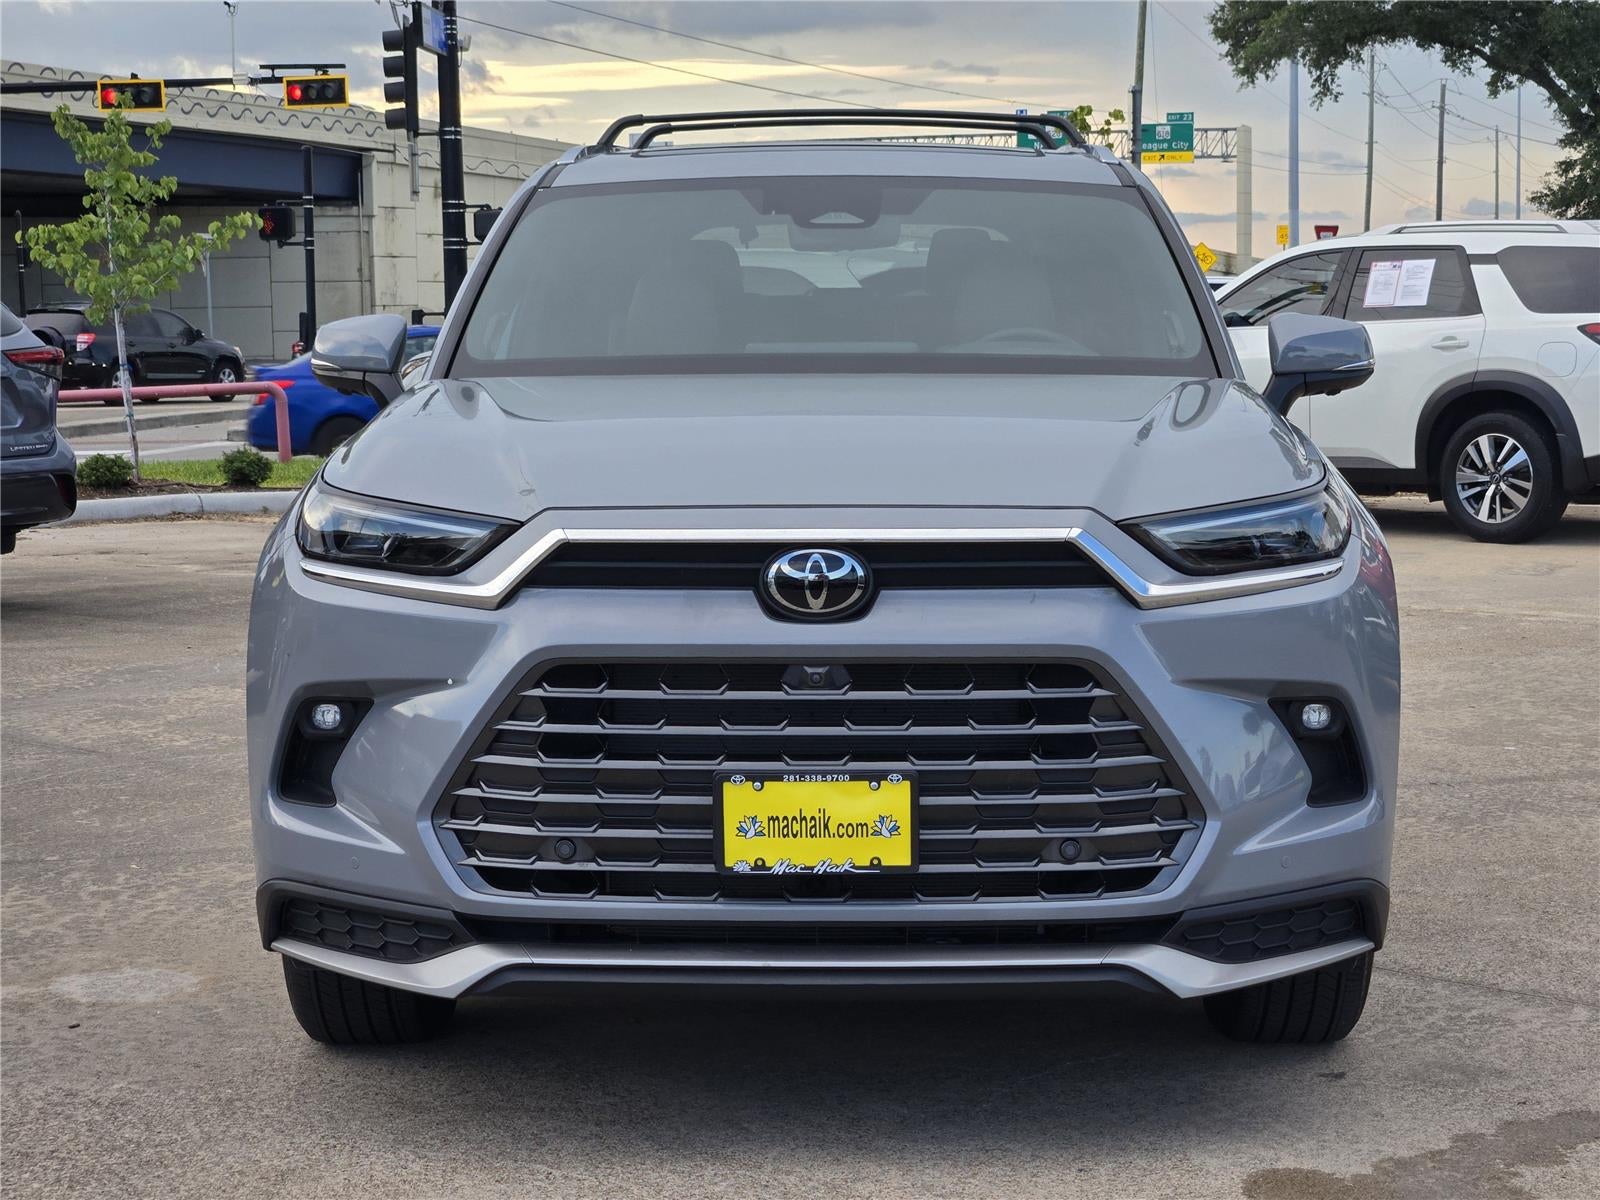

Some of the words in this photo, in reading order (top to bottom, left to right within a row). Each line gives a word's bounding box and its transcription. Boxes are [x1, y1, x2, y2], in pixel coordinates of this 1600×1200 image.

[1142, 142, 1168, 151] eague
[1172, 141, 1189, 150] City
[783, 774, 850, 782] 281-338-9700
[767, 808, 869, 839] machaik.com
[770, 858, 810, 875] Mac
[812, 858, 857, 875] Haik
